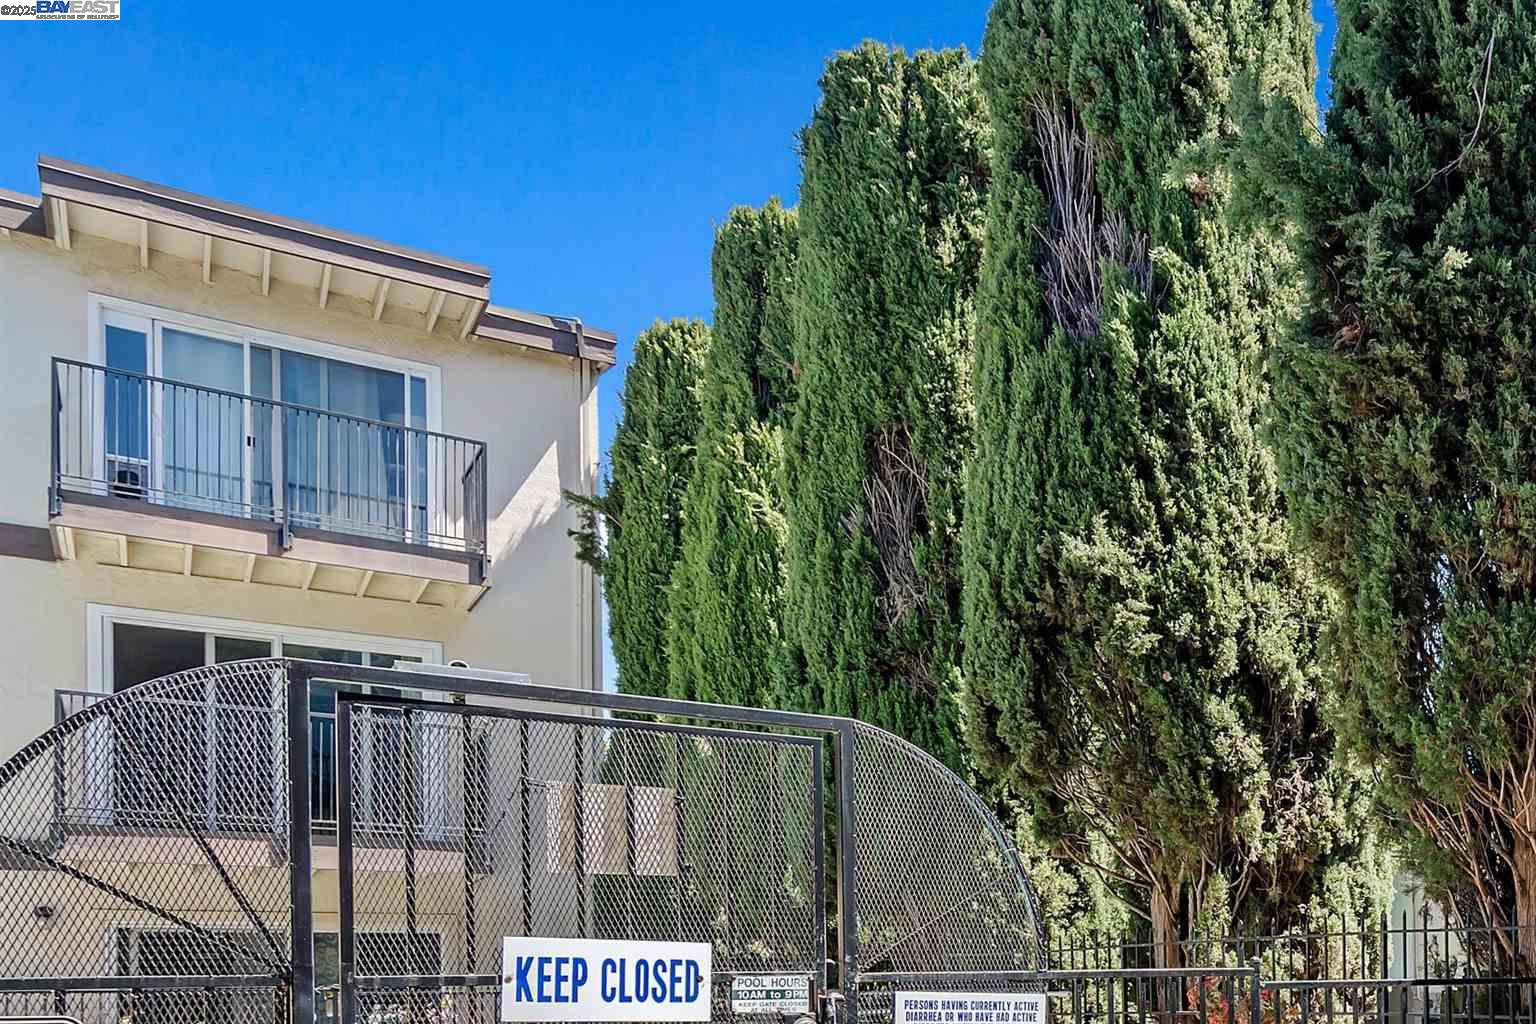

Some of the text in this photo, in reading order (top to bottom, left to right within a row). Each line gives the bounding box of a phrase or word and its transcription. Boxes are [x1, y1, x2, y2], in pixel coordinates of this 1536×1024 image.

[515, 956, 700, 1004] KEEP CLOSED
[738, 978, 808, 987] POOL HOURS
[737, 991, 808, 999] 10AM to 9PM
[904, 1000, 1039, 1011] PERSONS HAVING CURRENTLY ACTIVE
[905, 1012, 1037, 1022] DIARRHEA OR WHO HAVE HAD ACTIVE
